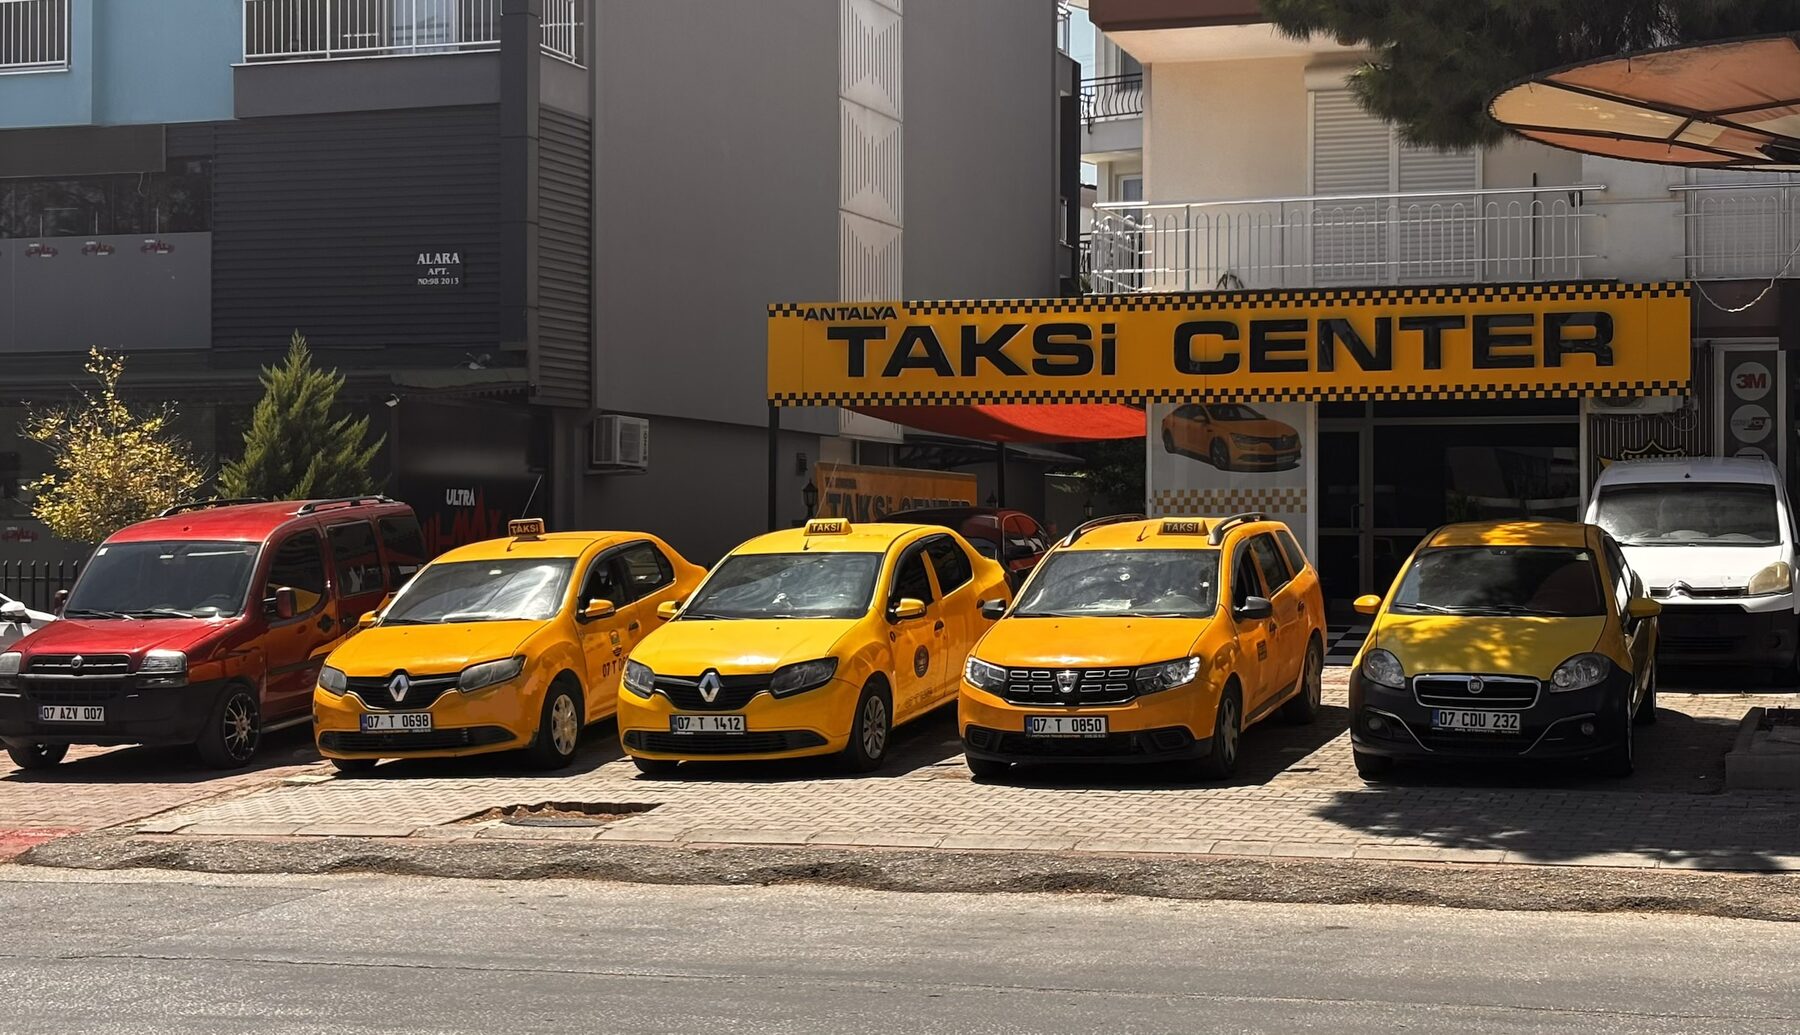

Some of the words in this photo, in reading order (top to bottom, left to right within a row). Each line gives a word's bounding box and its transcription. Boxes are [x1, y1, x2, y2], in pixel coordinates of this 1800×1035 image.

[416, 252, 461, 265] ALARA
[427, 267, 450, 275] APT.
[441, 277, 460, 285] 2013
[803, 306, 898, 321] ANTALYA
[1173, 311, 1615, 375] CENTER
[1736, 372, 1767, 390] 3M
[445, 487, 476, 507] ULTRA
[43, 707, 56, 720] 07
[83, 707, 103, 720] 007
[1440, 711, 1456, 726] 07
[1461, 712, 1487, 728] CDU
[1492, 713, 1518, 729] 232
[367, 715, 381, 729] 07
[388, 715, 396, 729] T
[402, 714, 430, 728] 0698
[677, 717, 691, 730] 07
[698, 717, 705, 730] T
[713, 717, 741, 730] 1412
[1033, 718, 1047, 732] 07
[1055, 718, 1062, 732] T
[1071, 718, 1102, 732] 0850
